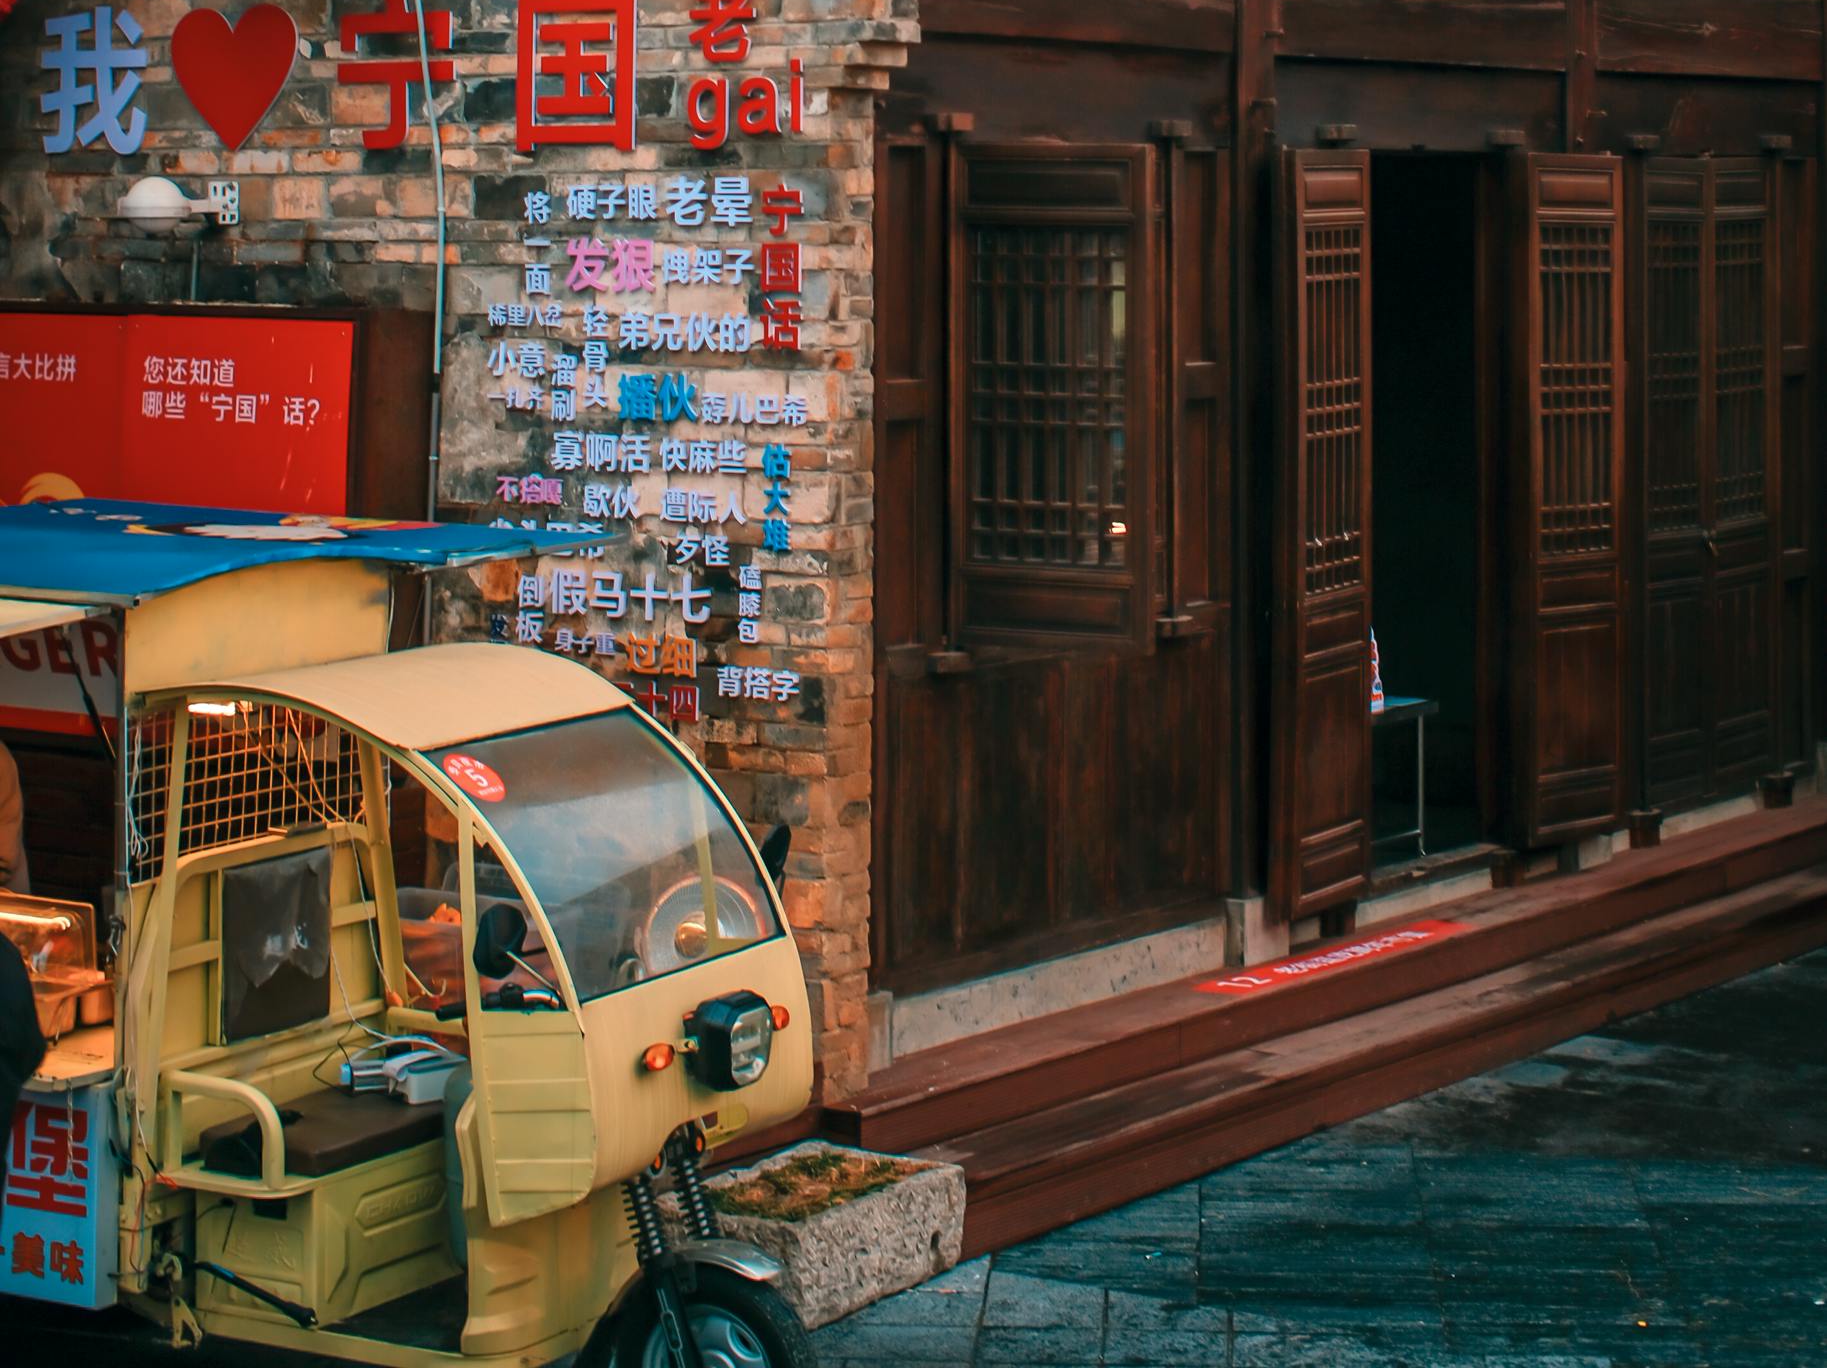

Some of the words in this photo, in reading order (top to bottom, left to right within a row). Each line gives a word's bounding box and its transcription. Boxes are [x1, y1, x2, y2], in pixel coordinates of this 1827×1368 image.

[41, 5, 148, 155] 我
[687, 58, 804, 150] gai
[566, 183, 657, 220] 硬子眼
[565, 237, 656, 293] 发狠
[760, 177, 804, 350] 宁国话
[618, 312, 751, 352] 弟兄伙的
[142, 356, 235, 388] 您还知道
[487, 339, 546, 378] 小意
[582, 304, 609, 408] 轻骨头
[659, 438, 748, 474] 快麻些
[583, 483, 641, 520] 歇伙
[659, 488, 747, 526] 遭际人
[515, 574, 545, 643] 倒板
[551, 568, 712, 624] 假马十七
[626, 631, 697, 678] 过细
[616, 681, 700, 722] 十四
[463, 768, 489, 788] 5
[7, 1101, 88, 1217] 堡
[0, 1232, 84, 1285] 美味
